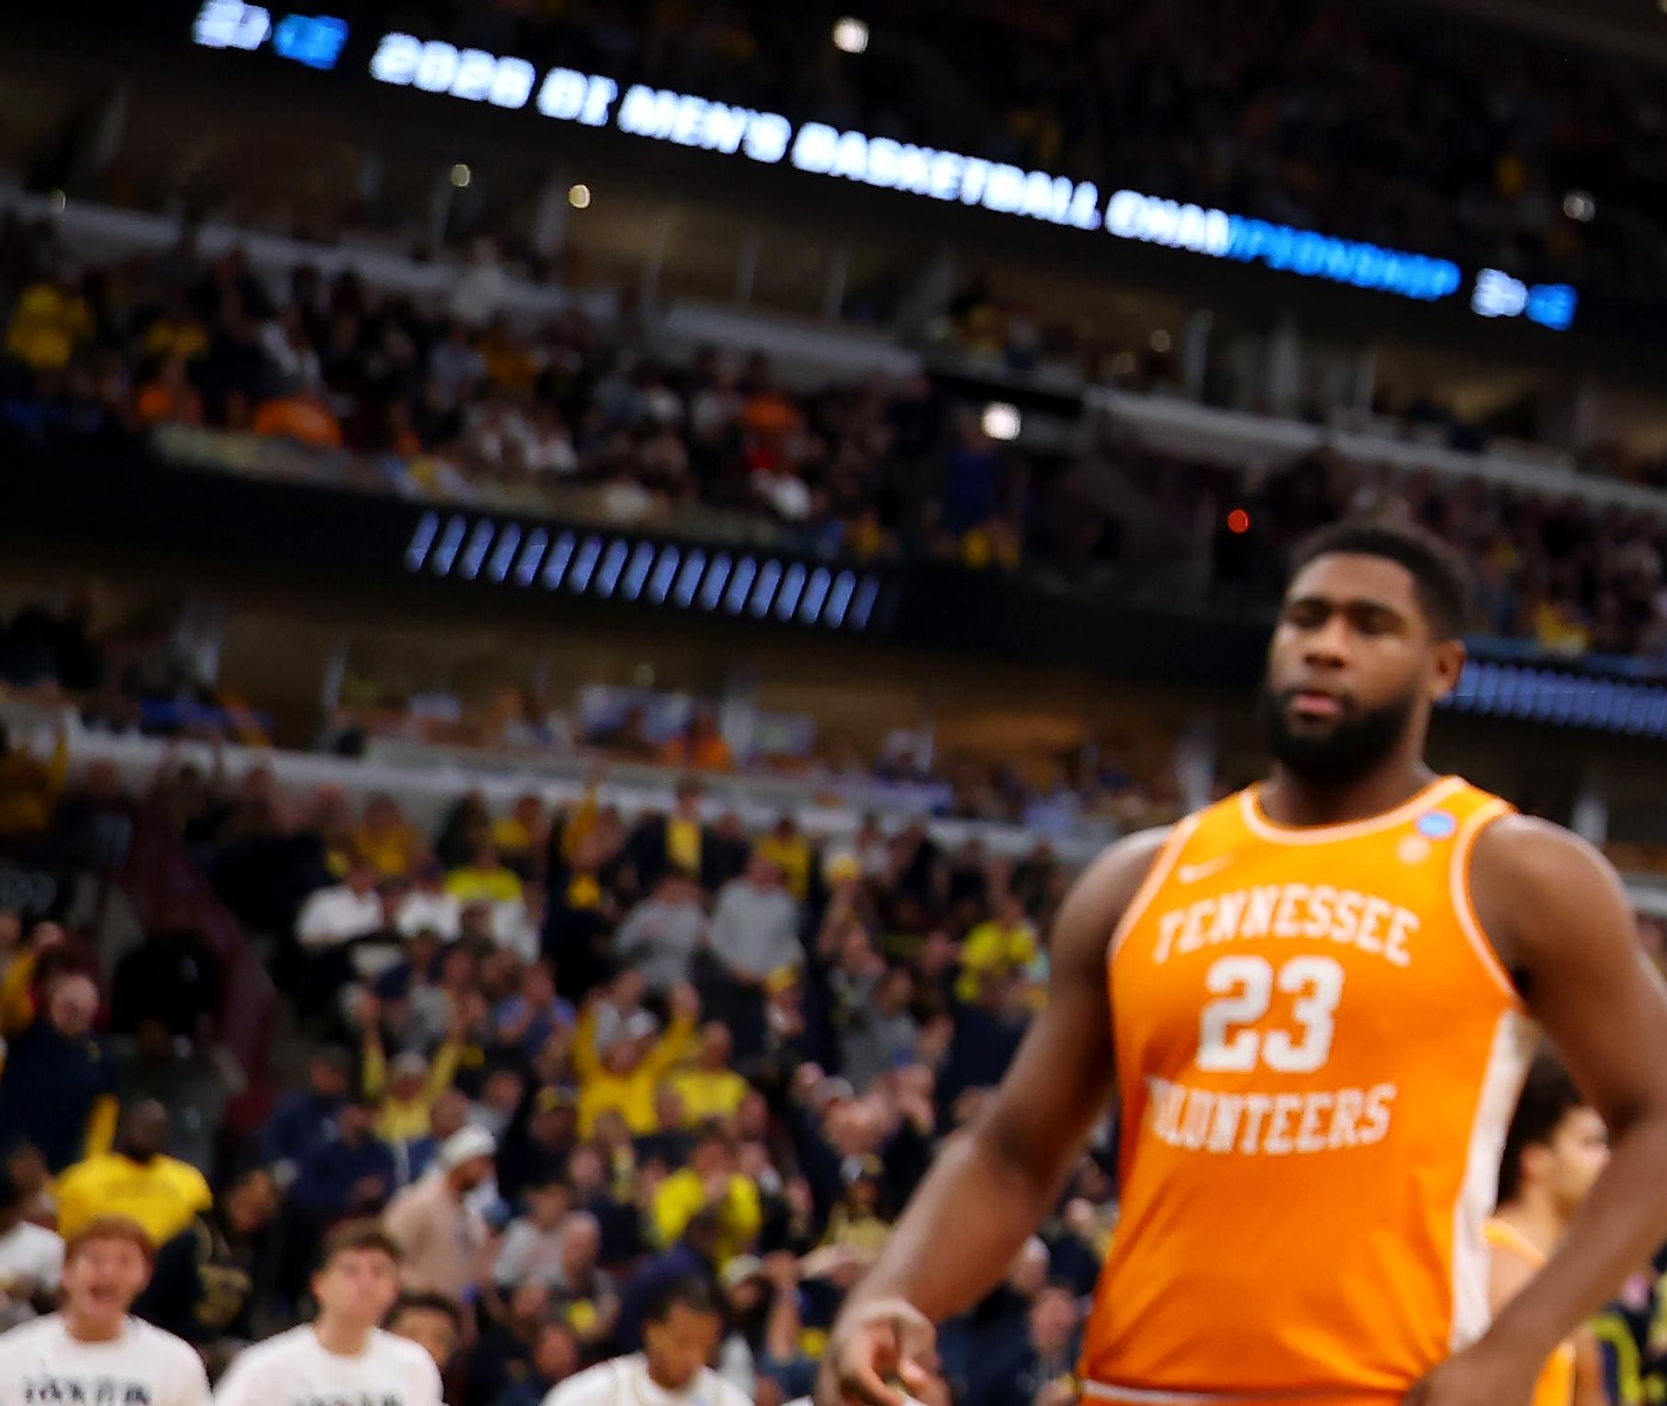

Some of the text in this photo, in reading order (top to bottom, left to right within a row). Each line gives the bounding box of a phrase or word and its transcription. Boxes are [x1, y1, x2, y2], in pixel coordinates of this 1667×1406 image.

[791, 120, 1100, 231] BASKETBALL
[1152, 883, 1420, 967] TENNESSEE
[1196, 955, 1345, 1073] 23
